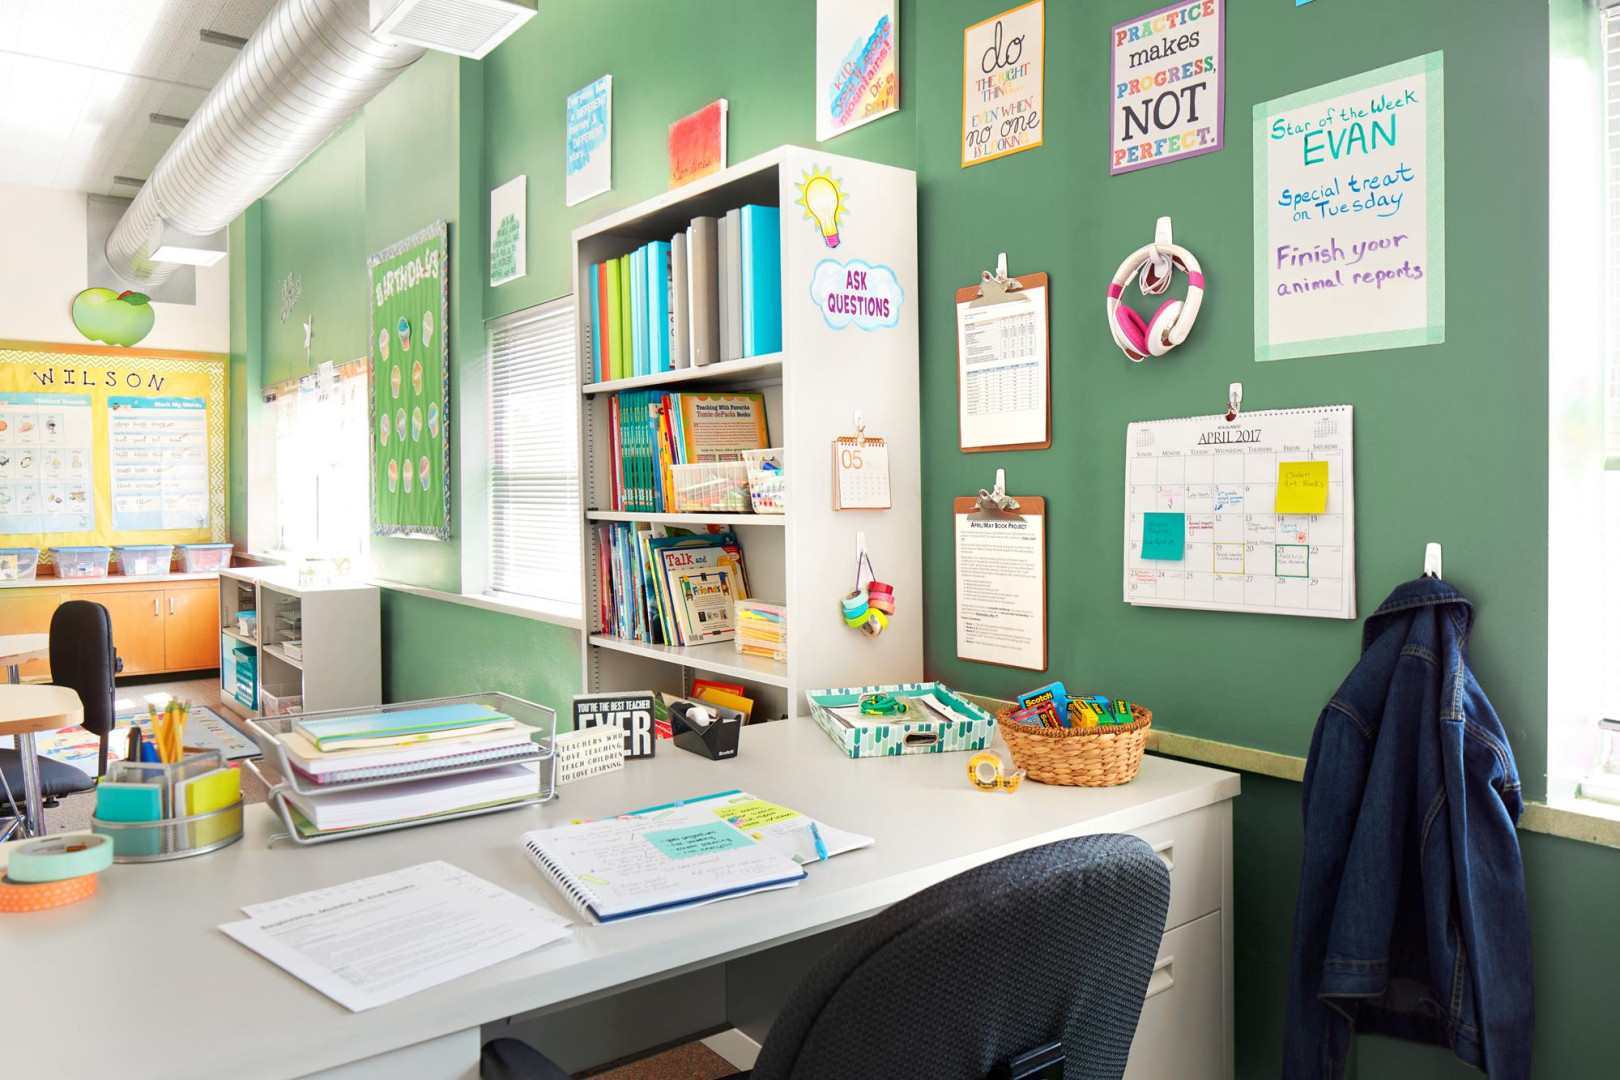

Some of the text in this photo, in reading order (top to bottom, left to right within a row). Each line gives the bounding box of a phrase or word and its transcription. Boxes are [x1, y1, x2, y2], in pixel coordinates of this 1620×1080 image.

[1116, 0, 1215, 47] PRACTICE
[863, 21, 890, 67] move
[981, 20, 1026, 74] do
[1129, 30, 1200, 69] makes
[840, 39, 892, 126] mountains!
[976, 62, 1031, 92] THE RIGHT
[1117, 55, 1216, 99] PROGRESS,
[972, 95, 1034, 128] EVEN WHEN
[1121, 81, 1207, 142] NOT
[1271, 90, 1418, 140] Star of the Week
[966, 111, 1041, 147] no one
[1303, 113, 1396, 166] EVAN
[1114, 126, 1215, 166] PERFECT.
[1278, 162, 1415, 211] Special treat
[1293, 191, 1403, 222] on Tuesday
[1277, 233, 1409, 270] Finish your
[846, 270, 867, 291] ASK
[1277, 260, 1424, 297] animal reports
[828, 293, 890, 318] QUESTIONS
[33, 368, 165, 391] WILSON
[1199, 429, 1262, 445] APRIL 2017
[841, 449, 863, 470] 05
[1285, 471, 1311, 480] Order
[1302, 480, 1324, 488] Books
[666, 553, 694, 567] Talk
[692, 585, 721, 595] Friends
[578, 699, 650, 713] YOU'RE THE BEST TEACHER
[1025, 692, 1053, 707] Scotch
[561, 752, 580, 762] LOVE
[562, 732, 623, 752] TEACHERS WHO
[561, 751, 623, 772] TEACH CHILDREN
[561, 774, 571, 782] TO
[572, 769, 588, 779] LOVE
